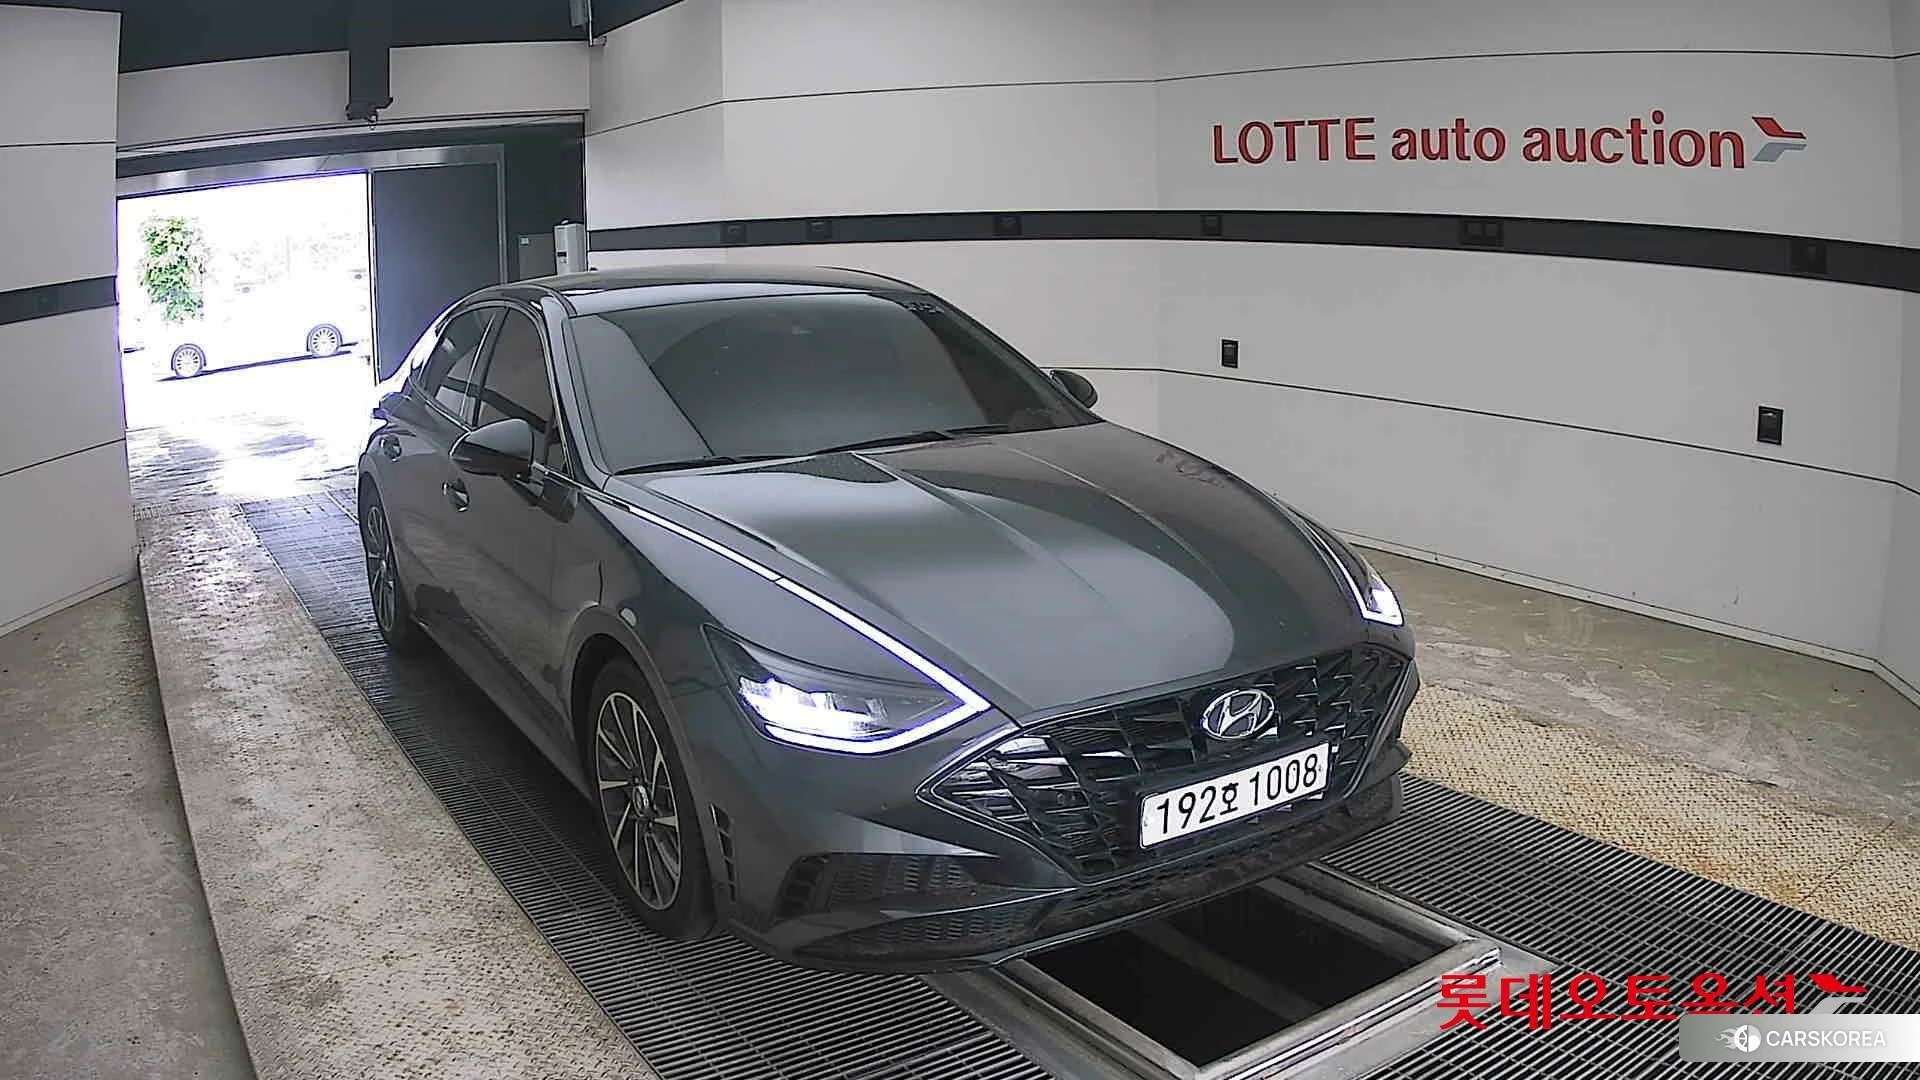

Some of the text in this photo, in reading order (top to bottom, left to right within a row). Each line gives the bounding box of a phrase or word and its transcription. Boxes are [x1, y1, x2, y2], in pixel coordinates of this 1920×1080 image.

[1212, 110, 1745, 169] LOTTE auto auction
[1156, 753, 1319, 834] 192호 1008
